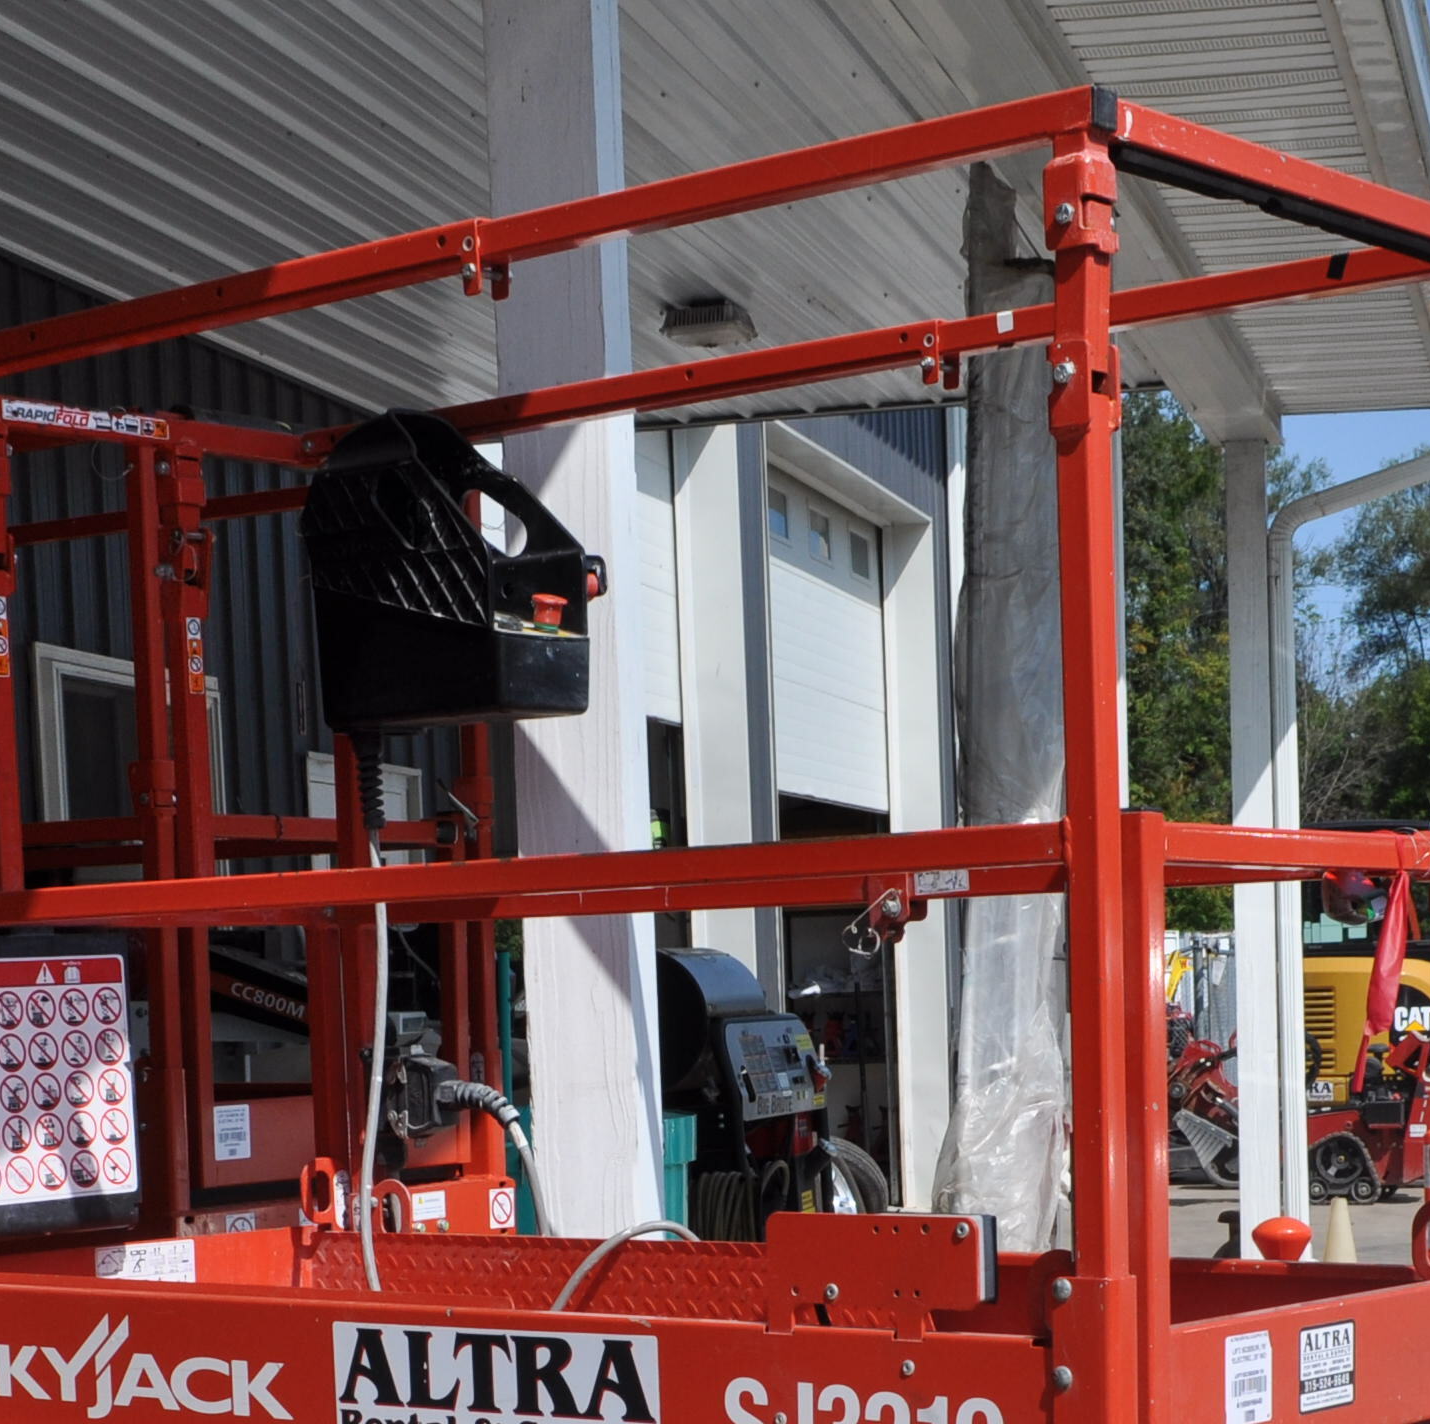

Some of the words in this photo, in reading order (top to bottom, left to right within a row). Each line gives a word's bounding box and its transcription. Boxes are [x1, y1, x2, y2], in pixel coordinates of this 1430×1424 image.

[231, 982, 305, 1019] CC800M
[1304, 1328, 1350, 1352] ALTRA
[340, 1328, 656, 1424] ALTRA
